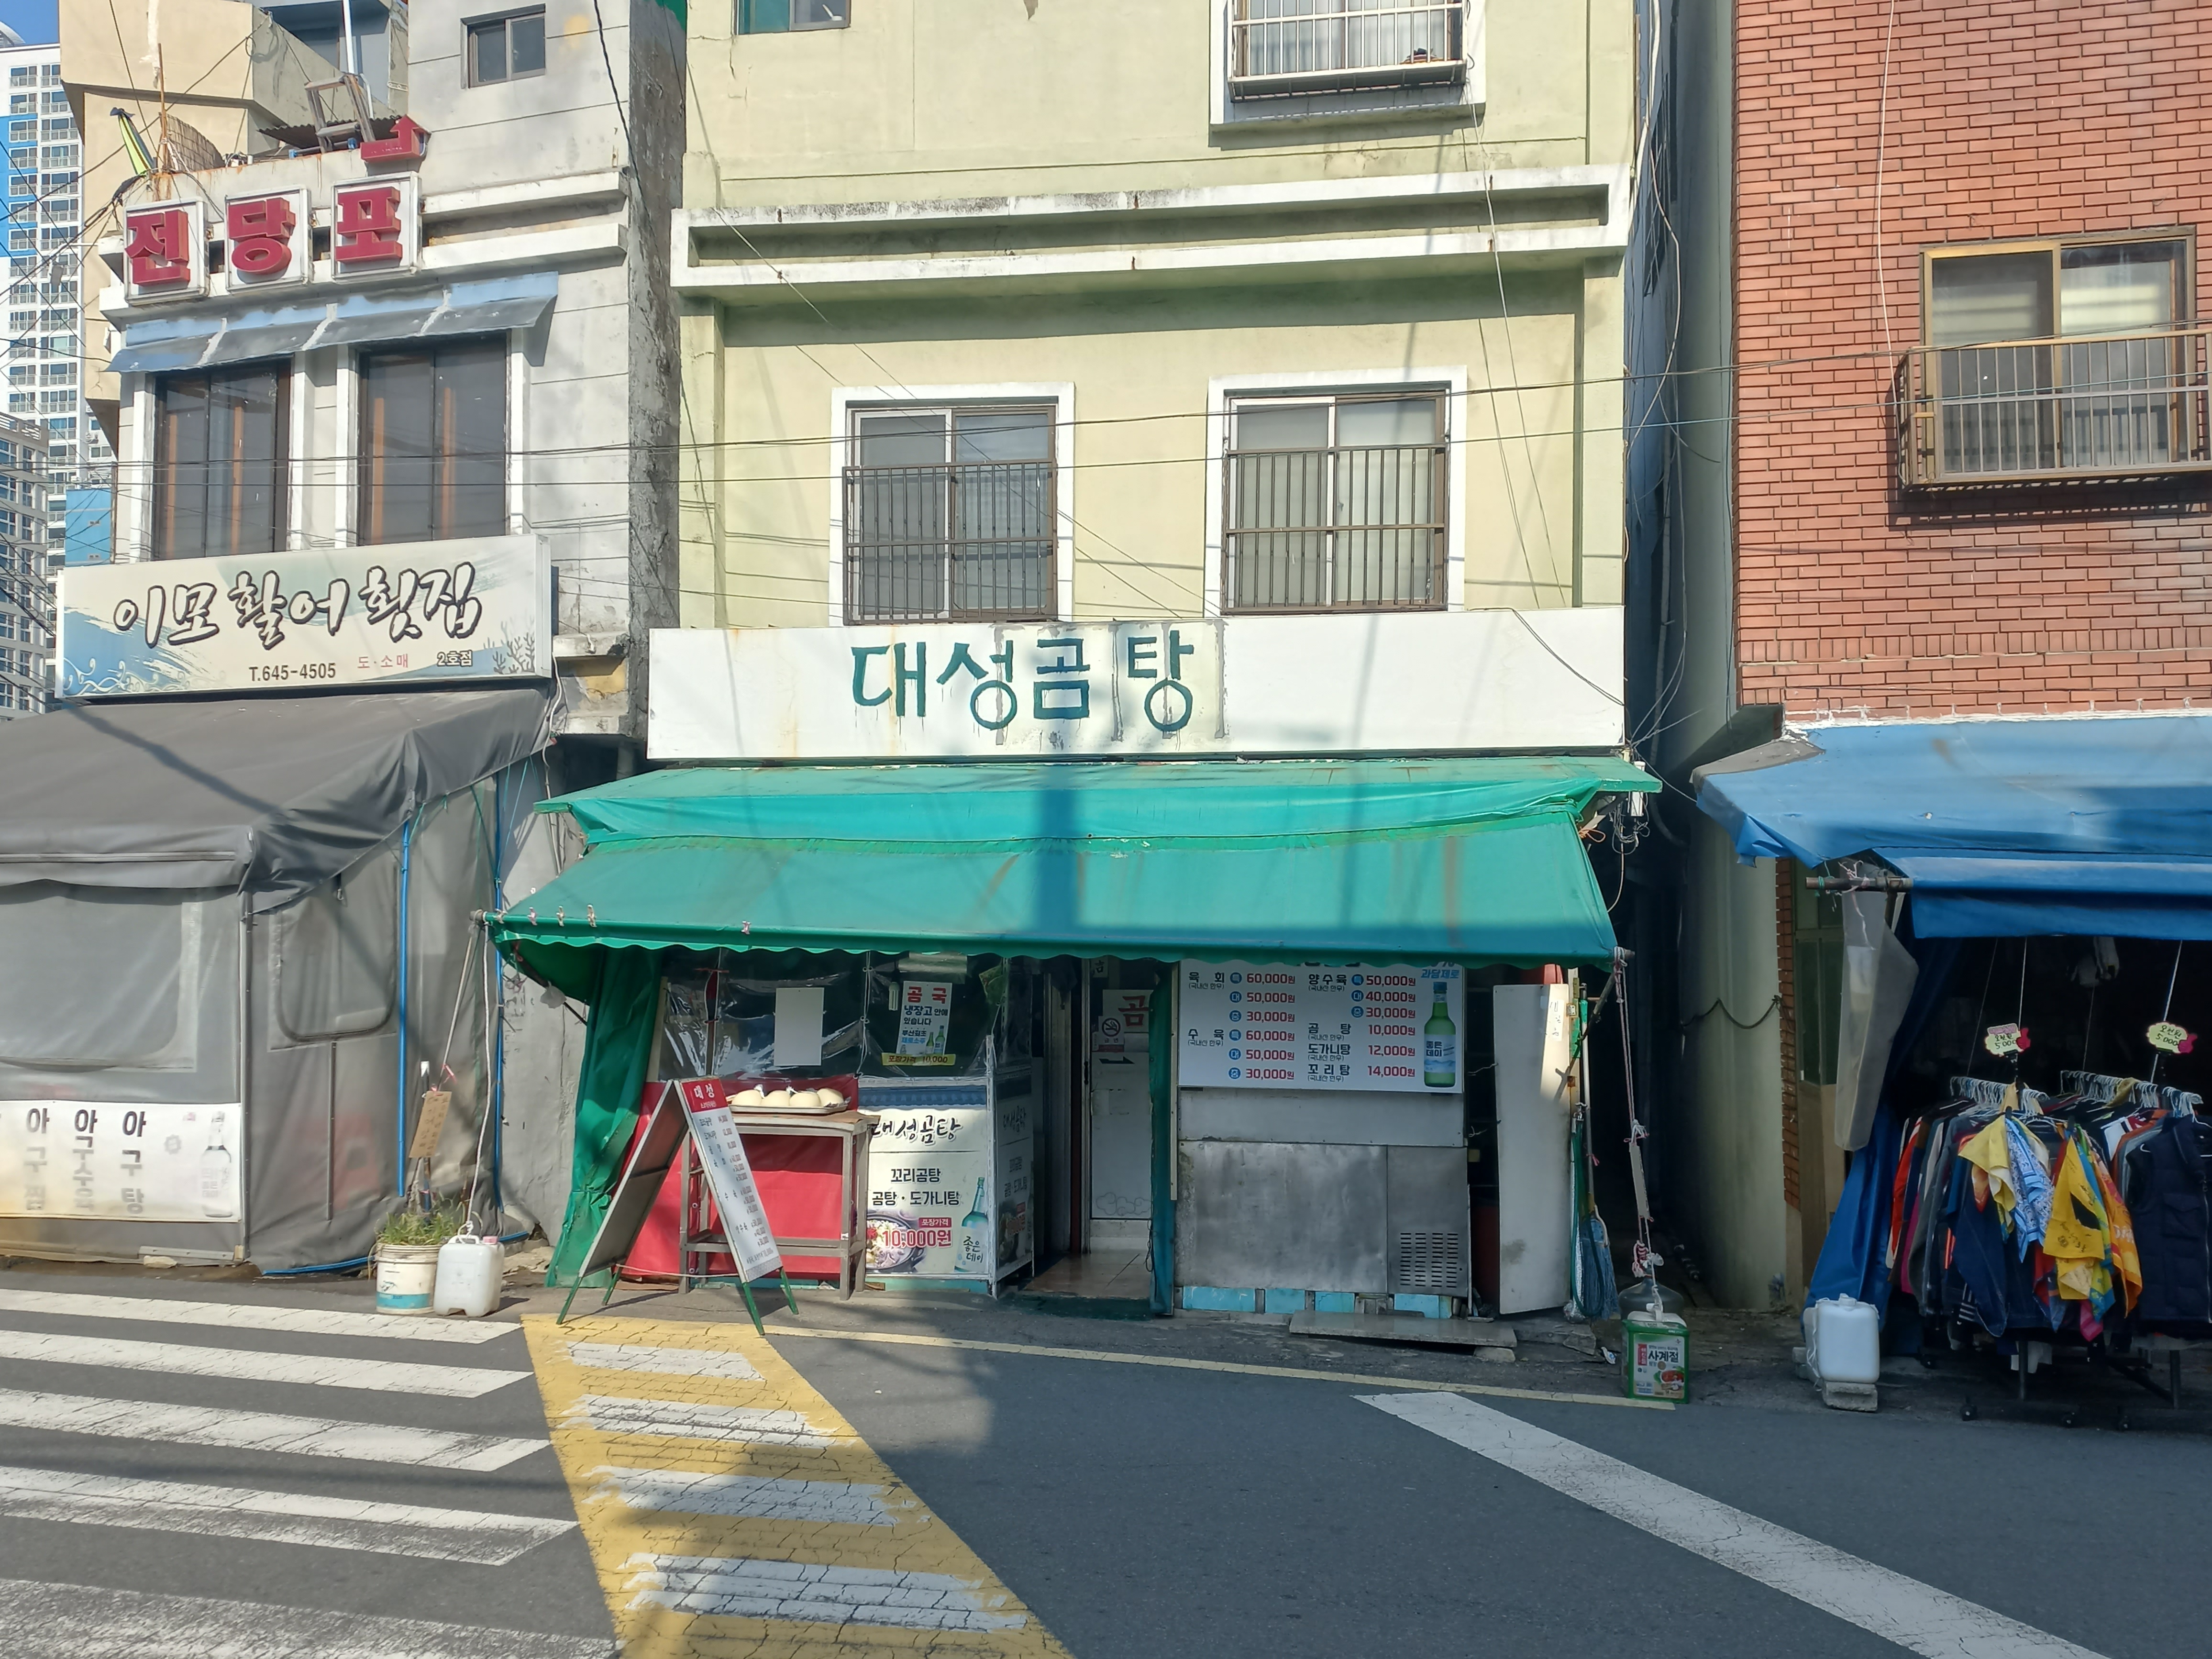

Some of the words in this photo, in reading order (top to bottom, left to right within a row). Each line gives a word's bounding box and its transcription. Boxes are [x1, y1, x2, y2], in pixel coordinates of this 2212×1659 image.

[124, 186, 402, 286] 전당포
[113, 582, 220, 648] 이모
[228, 570, 351, 650] 활어
[359, 561, 483, 643] 횟집
[436, 650, 473, 667] 2호점
[248, 663, 337, 683] T.645-4505
[851, 630, 1194, 732] 대성곰탕
[1247, 973, 1295, 984] 60,000원
[1366, 975, 1416, 987] 50,000원
[1247, 992, 1295, 1004] 50,000원
[1365, 991, 1416, 1003] 40,000원
[904, 1005, 932, 1016] 냉장고
[1118, 995, 1149, 1027] 곰
[1366, 1007, 1416, 1019] 30,000원
[904, 1017, 932, 1026] 있습니다
[1247, 1011, 1295, 1023] 30,000원
[1246, 1030, 1294, 1042] 60,000원
[1368, 1024, 1416, 1036] 10,000원
[1246, 1049, 1294, 1061] 50,000원
[1308, 1043, 1351, 1055] 도가니탕
[1368, 1045, 1415, 1057] 12,000원
[922, 1056, 948, 1064] 10,000
[1246, 1068, 1294, 1080] 30,000원
[1367, 1065, 1415, 1077] 14,000원
[872, 1115, 961, 1144] 대성곰탕
[891, 1168, 941, 1183] 꼬리곰탕
[872, 1191, 897, 1206] 곰탕
[910, 1191, 960, 1206] 도가니탕
[921, 1218, 949, 1227] 포장가격
[883, 1229, 952, 1248] 10,000원
[963, 1236, 981, 1252] 좋은
[1648, 1350, 1679, 1363] 사계절
